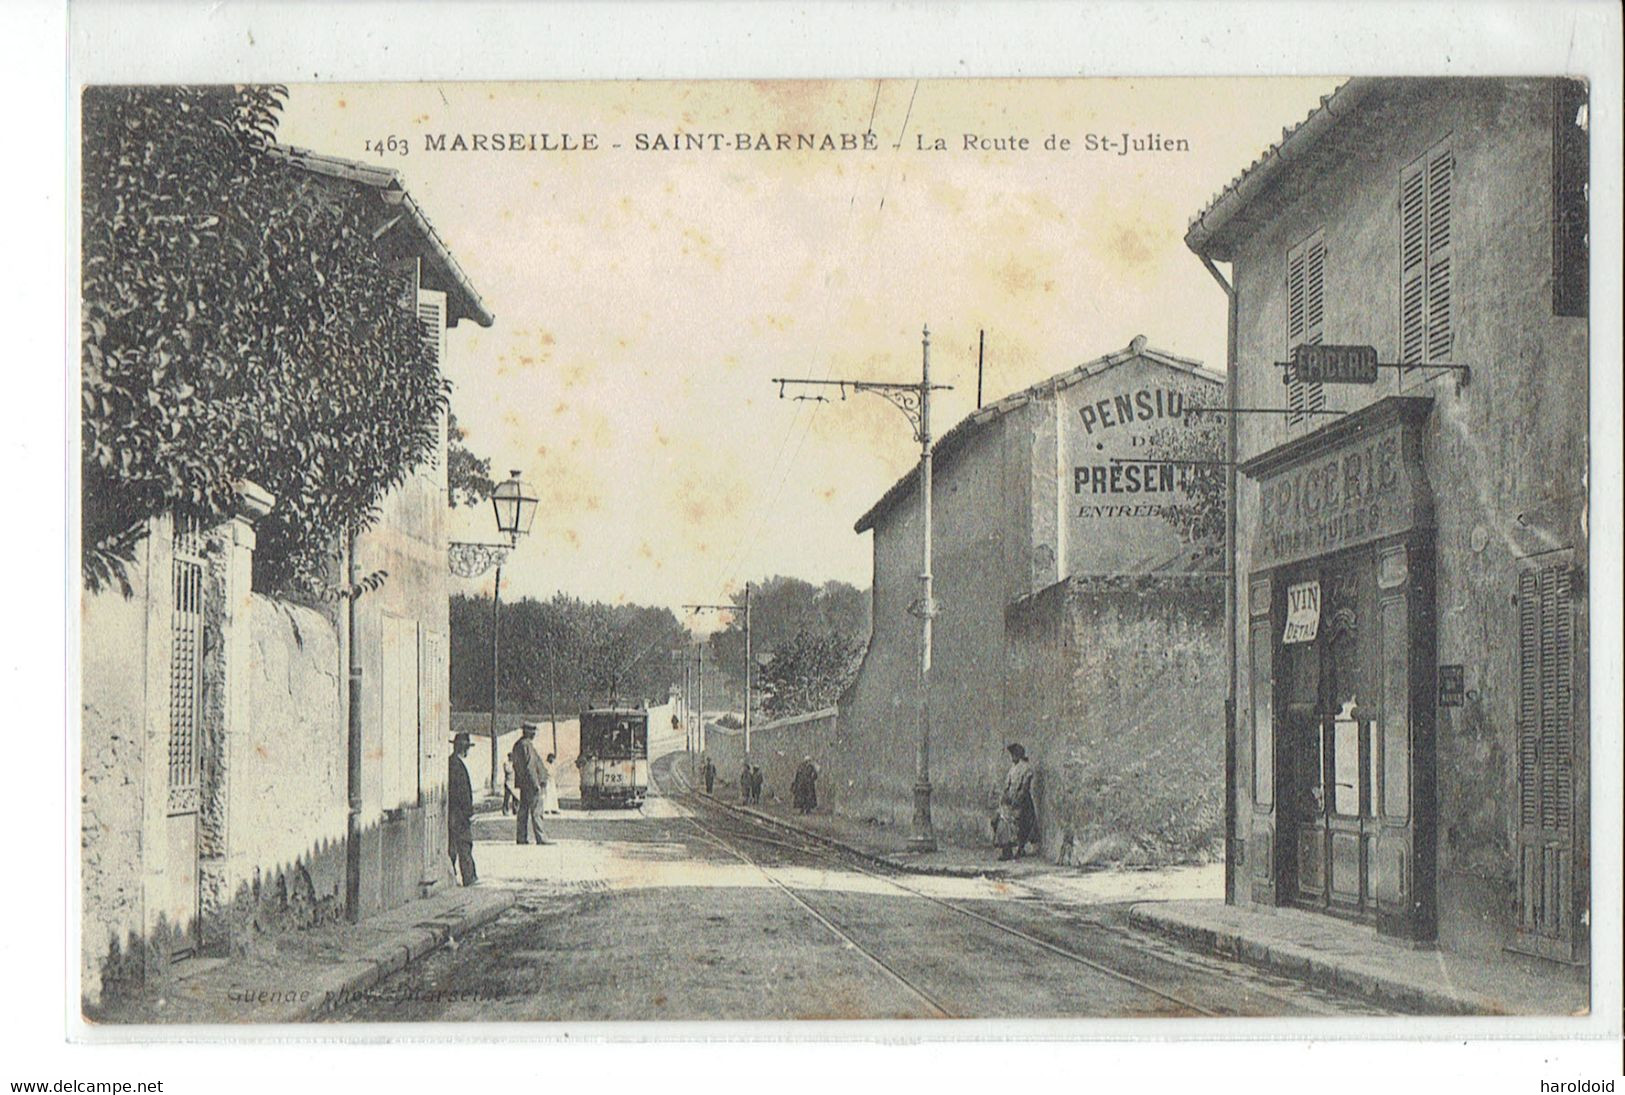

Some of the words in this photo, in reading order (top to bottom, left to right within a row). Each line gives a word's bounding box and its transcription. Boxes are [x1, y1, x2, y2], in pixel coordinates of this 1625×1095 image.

[1078, 389, 1190, 434] PENSIO
[1261, 437, 1400, 530] EPICERIE
[1290, 586, 1318, 613] VIN
